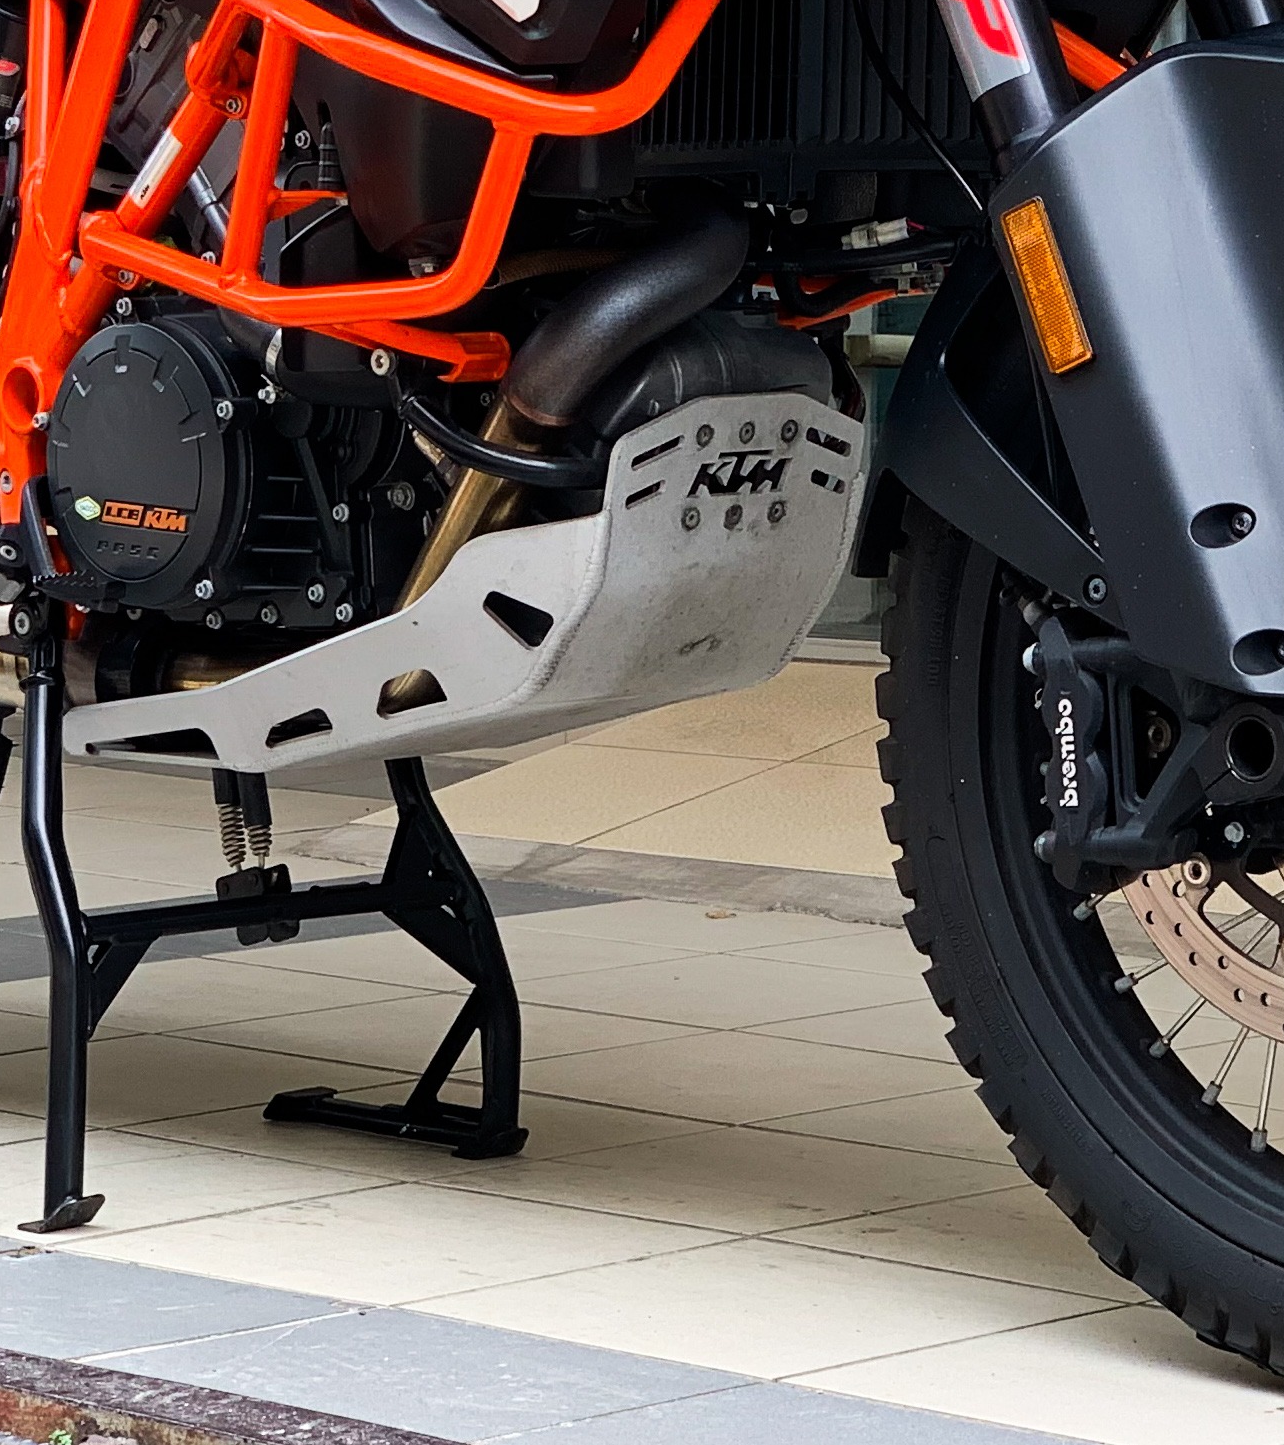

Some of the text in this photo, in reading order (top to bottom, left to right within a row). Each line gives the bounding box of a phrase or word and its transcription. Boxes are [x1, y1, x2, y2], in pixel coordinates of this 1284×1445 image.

[685, 448, 793, 498] KTM
[142, 507, 189, 533] KTM
[1054, 698, 1079, 807] brembo
